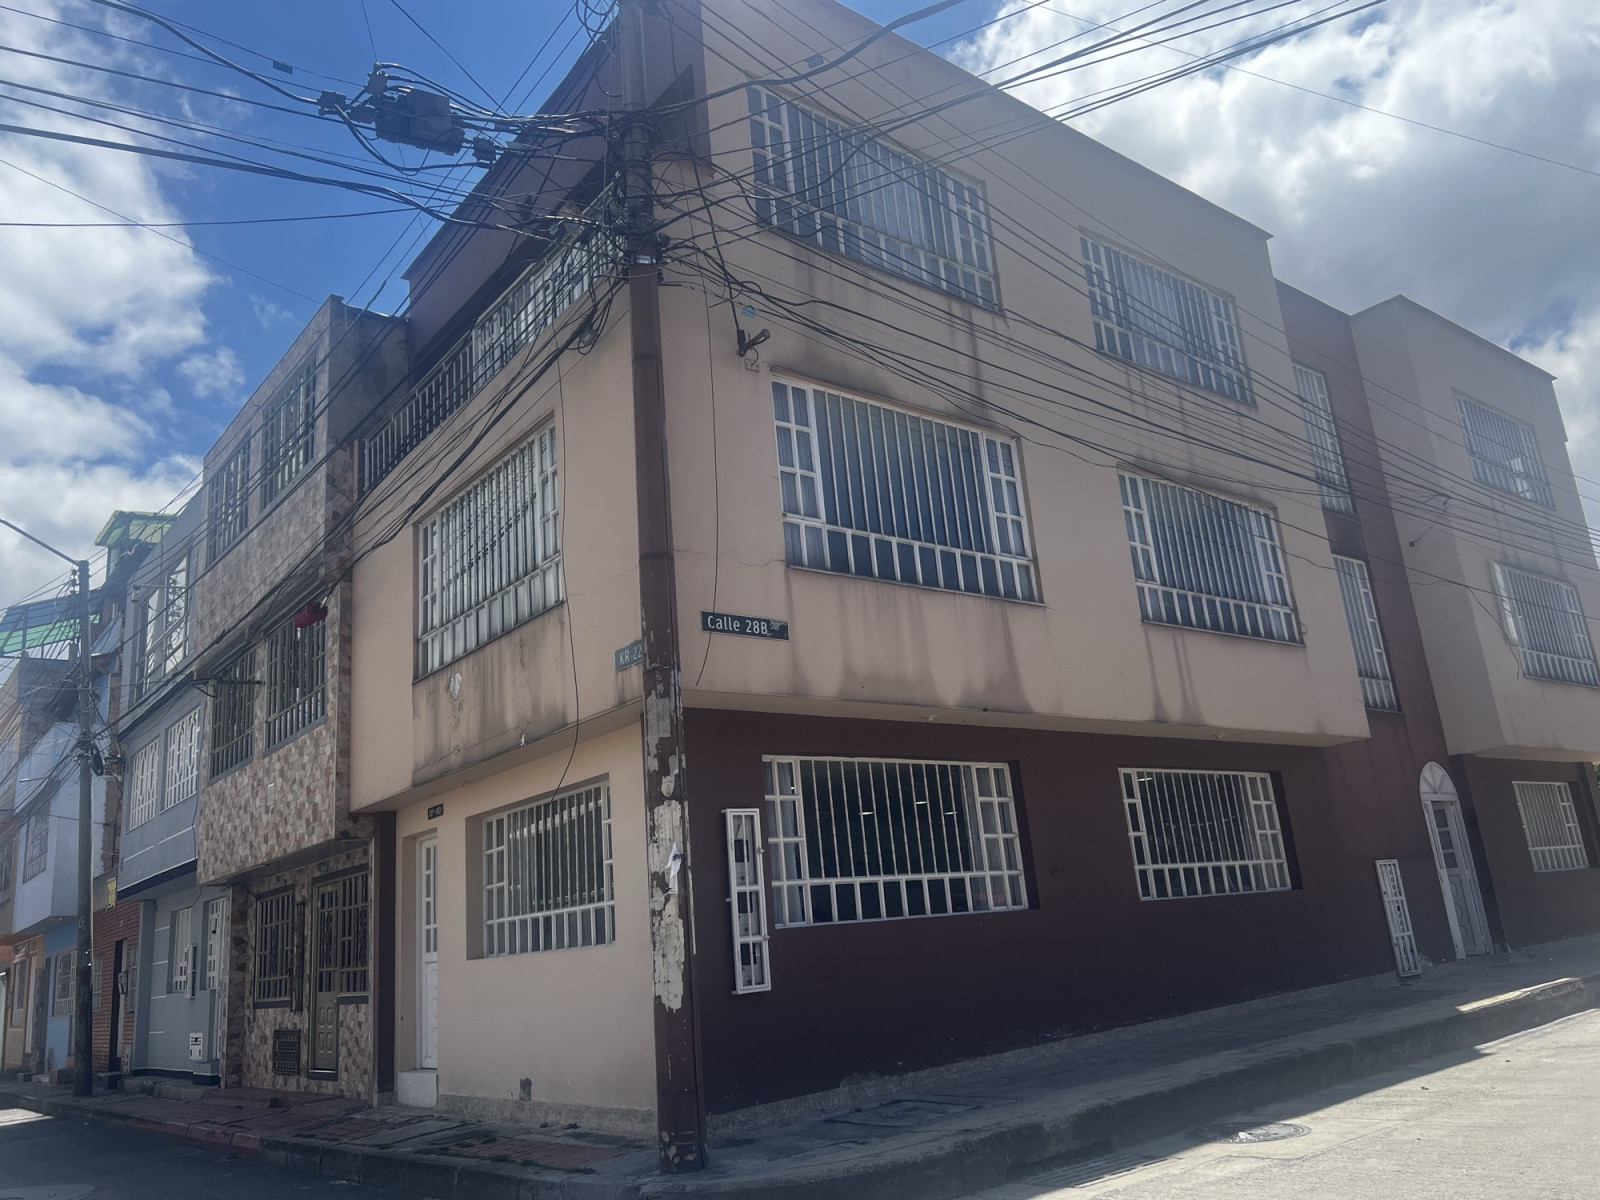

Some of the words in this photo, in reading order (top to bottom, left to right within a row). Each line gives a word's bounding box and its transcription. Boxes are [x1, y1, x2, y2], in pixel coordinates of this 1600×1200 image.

[707, 616, 740, 631] Calle
[745, 620, 768, 634] 28B
[619, 650, 630, 665] KR
[632, 644, 643, 660] 22
